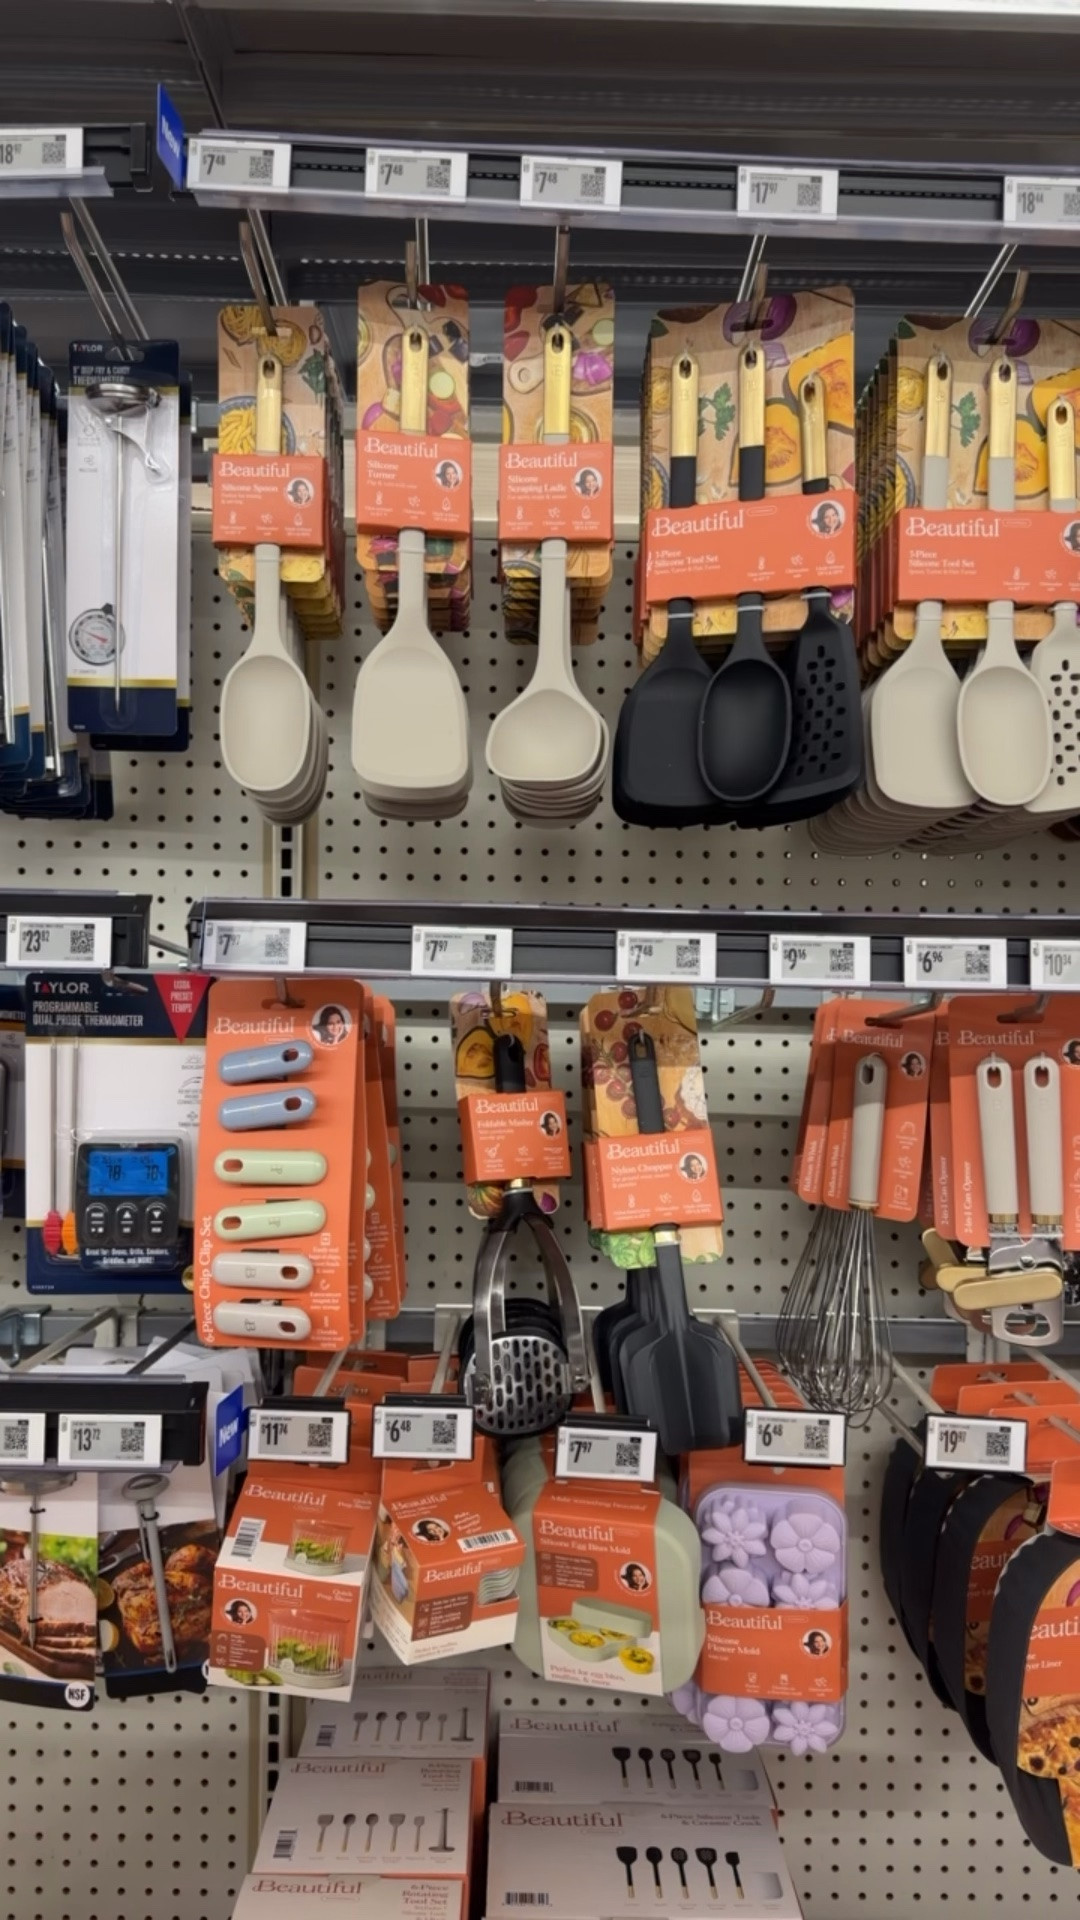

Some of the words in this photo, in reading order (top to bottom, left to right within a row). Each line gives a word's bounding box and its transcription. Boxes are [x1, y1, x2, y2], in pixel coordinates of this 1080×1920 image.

[364, 437, 439, 458] Beautiful
[367, 460, 399, 471] Silicone
[505, 452, 578, 469] Beautiful
[218, 461, 290, 478] Beautiful
[368, 469, 396, 479] Turner
[508, 475, 538, 483] Silicone
[221, 484, 252, 492] Silicone
[253, 485, 278, 494] Spoon
[508, 484, 543, 494] Scraping
[652, 509, 745, 537] Beautiful
[905, 516, 1000, 537] Beautiful
[654, 559, 685, 568] Silicone
[685, 556, 705, 565] Tool
[706, 554, 719, 562] Set
[909, 559, 940, 568] Silicone
[942, 559, 960, 568] Tool
[962, 560, 975, 568] Set
[33, 981, 90, 994] TAYLOR
[173, 979, 191, 990] USDA
[170, 991, 193, 1001] PRESET
[32, 1000, 99, 1013] PROGRAMMABLE
[171, 1003, 192, 1013] TEMPS
[32, 1013, 55, 1026] DUAL
[56, 1014, 82, 1026] PROBE
[85, 1014, 144, 1027] THERMOMETER
[213, 1016, 295, 1034] Beautiful
[841, 1029, 903, 1048] Beautiful
[957, 1030, 1035, 1046] Beautiful
[475, 1097, 539, 1114] Beautiful
[606, 1139, 680, 1160] Beautiful
[610, 1166, 637, 1176] Nylon
[637, 1163, 673, 1174] Chopper
[939, 1156, 947, 1186] Opener
[963, 1161, 972, 1191] Opener
[940, 1187, 948, 1201] Can
[963, 1193, 972, 1206] Can
[200, 1216, 212, 1237] Set
[199, 1240, 213, 1266] Clip
[199, 1270, 213, 1299] Chip
[202, 1303, 214, 1342] 6-Piece
[219, 1418, 240, 1448] New
[245, 1484, 328, 1507] Beautiful
[391, 1493, 449, 1512] Beautiful
[539, 1519, 614, 1542] Beautiful
[539, 1537, 570, 1548] Silicone
[571, 1541, 587, 1552] Egg
[609, 1545, 631, 1555] Mold
[423, 1560, 484, 1584] Beautiful
[218, 1574, 303, 1599] Beautiful
[706, 1610, 783, 1631] Beautiful
[707, 1633, 740, 1645] Silicone
[707, 1643, 736, 1654] Flower
[737, 1646, 760, 1656] Mold
[1041, 1660, 1063, 1669] Liner
[67, 1687, 88, 1701] NSF
[510, 1718, 620, 1733] Beautiful
[291, 1762, 387, 1775] Beautiful
[501, 1811, 625, 1828] Beautiful
[252, 1881, 362, 1895] Beautiful
